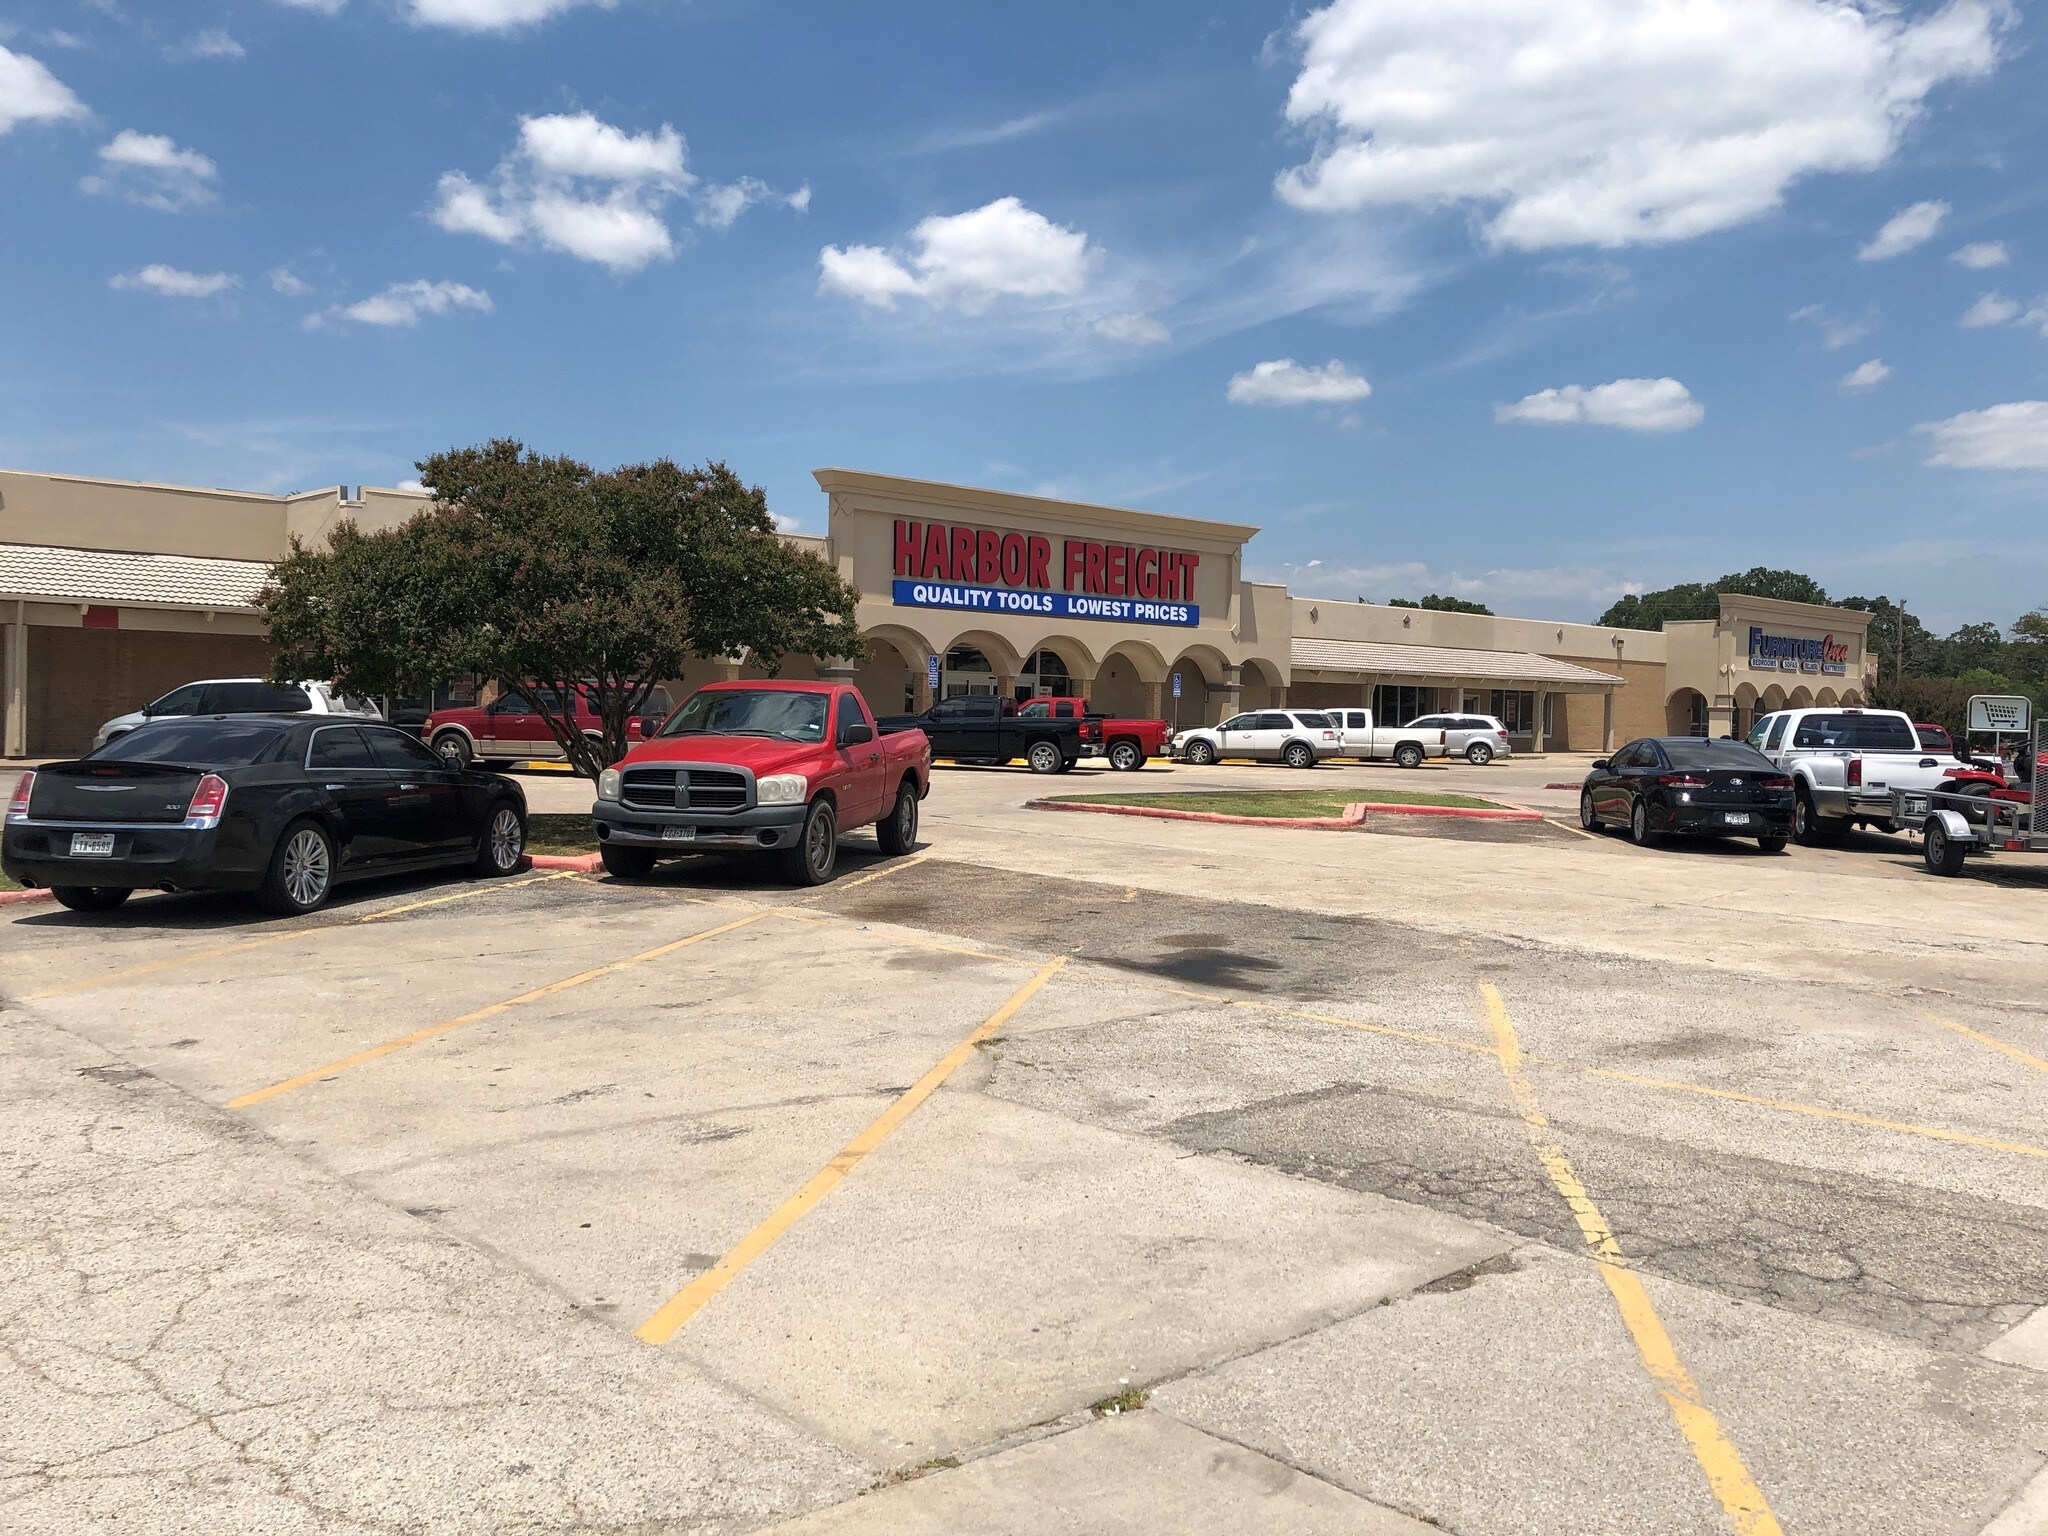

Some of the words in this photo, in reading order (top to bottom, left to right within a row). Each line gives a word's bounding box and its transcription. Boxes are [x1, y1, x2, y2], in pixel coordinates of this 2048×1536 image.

[893, 519, 1051, 590] HARBOR
[1063, 540, 1199, 601] FREIGHT
[913, 585, 993, 607] QUALITY
[996, 592, 1053, 612] TOOLS
[1067, 597, 1132, 617] LOWEST
[1134, 605, 1188, 622] PRICES
[1784, 660, 1798, 669] SOFAS
